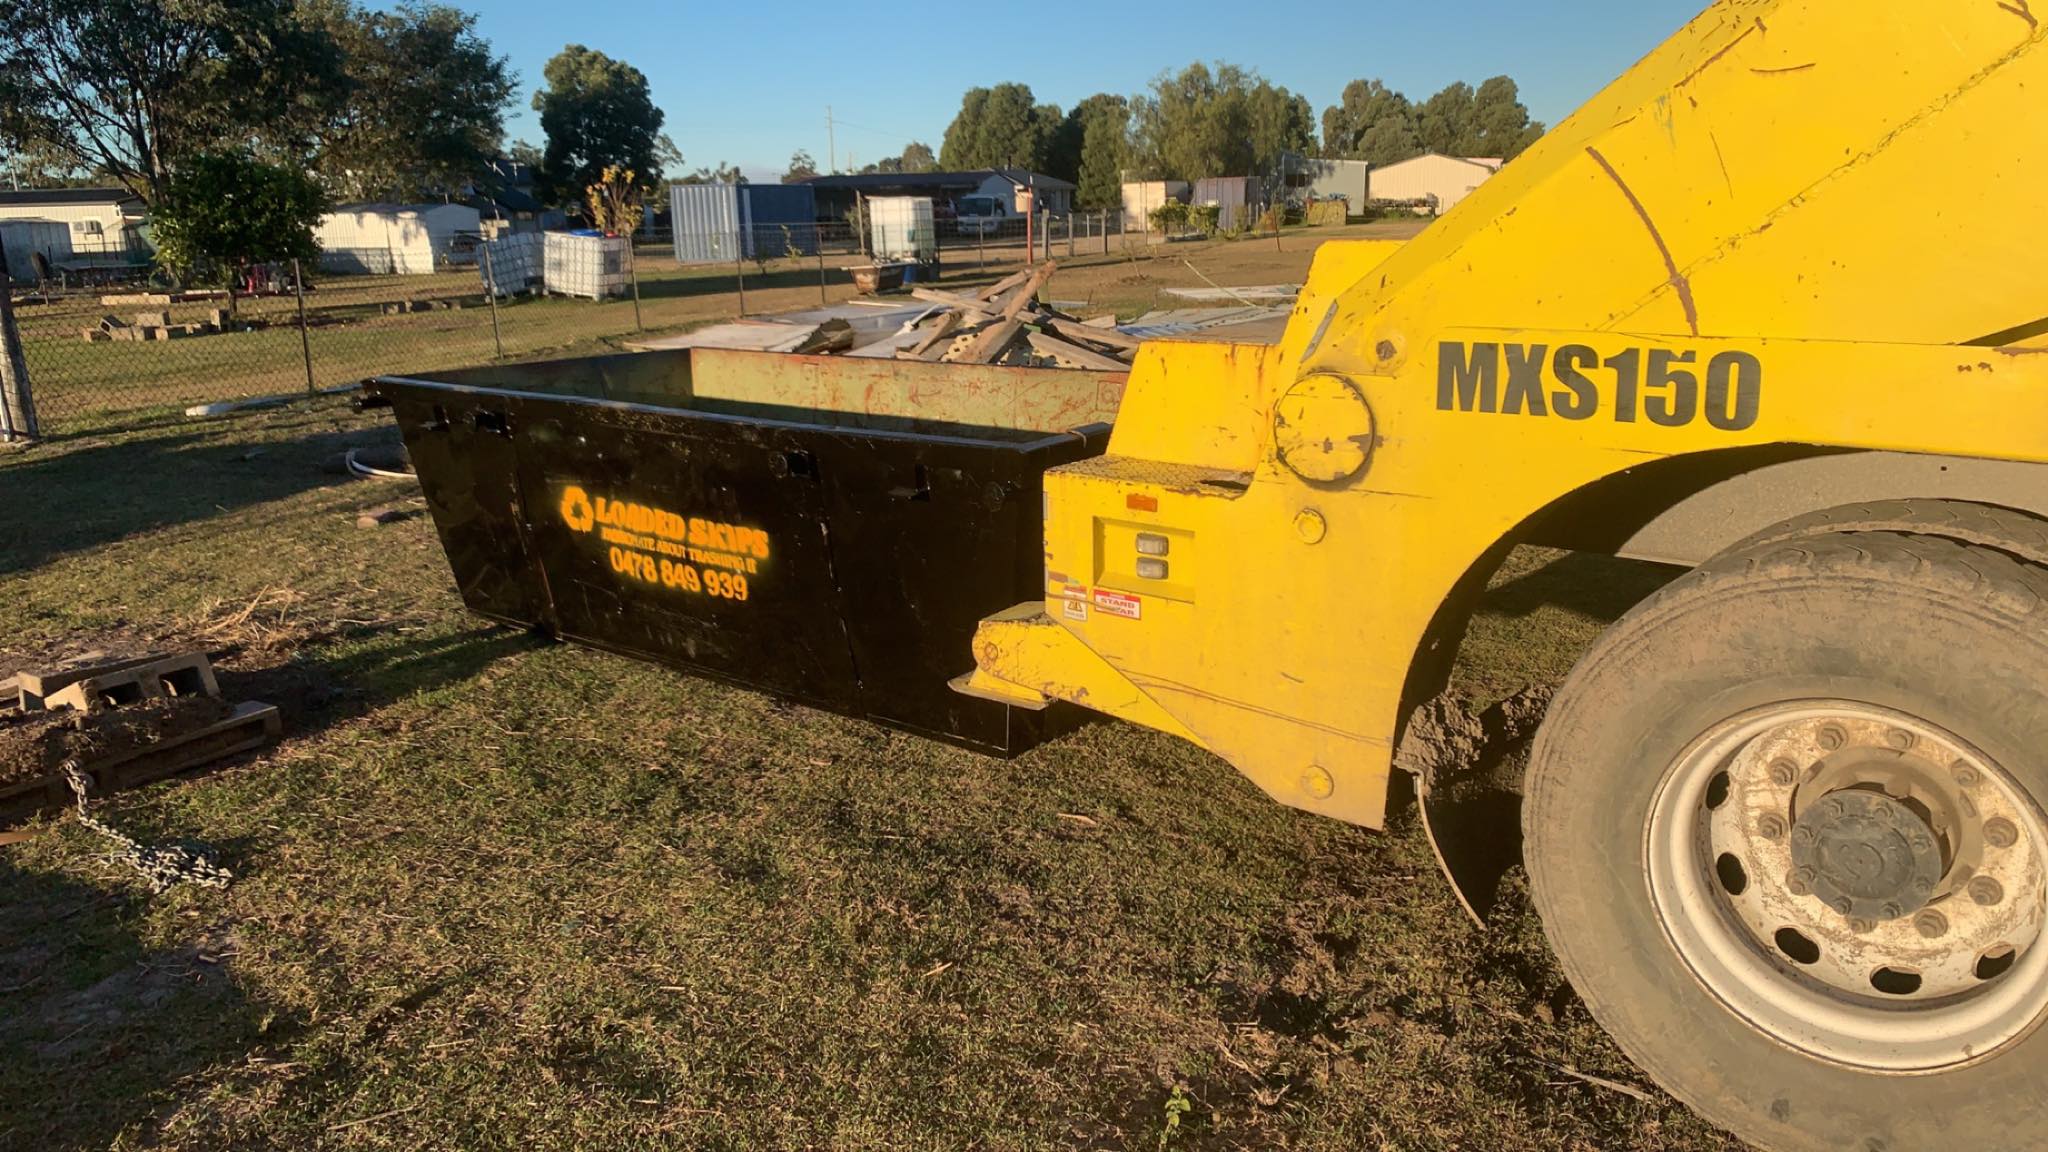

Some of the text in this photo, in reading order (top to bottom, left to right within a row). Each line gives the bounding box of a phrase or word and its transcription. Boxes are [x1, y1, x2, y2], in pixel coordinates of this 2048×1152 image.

[1436, 341, 1761, 431] MXS150
[595, 497, 769, 559] LOADED SKIPS
[610, 547, 748, 601] 0478 849 939
